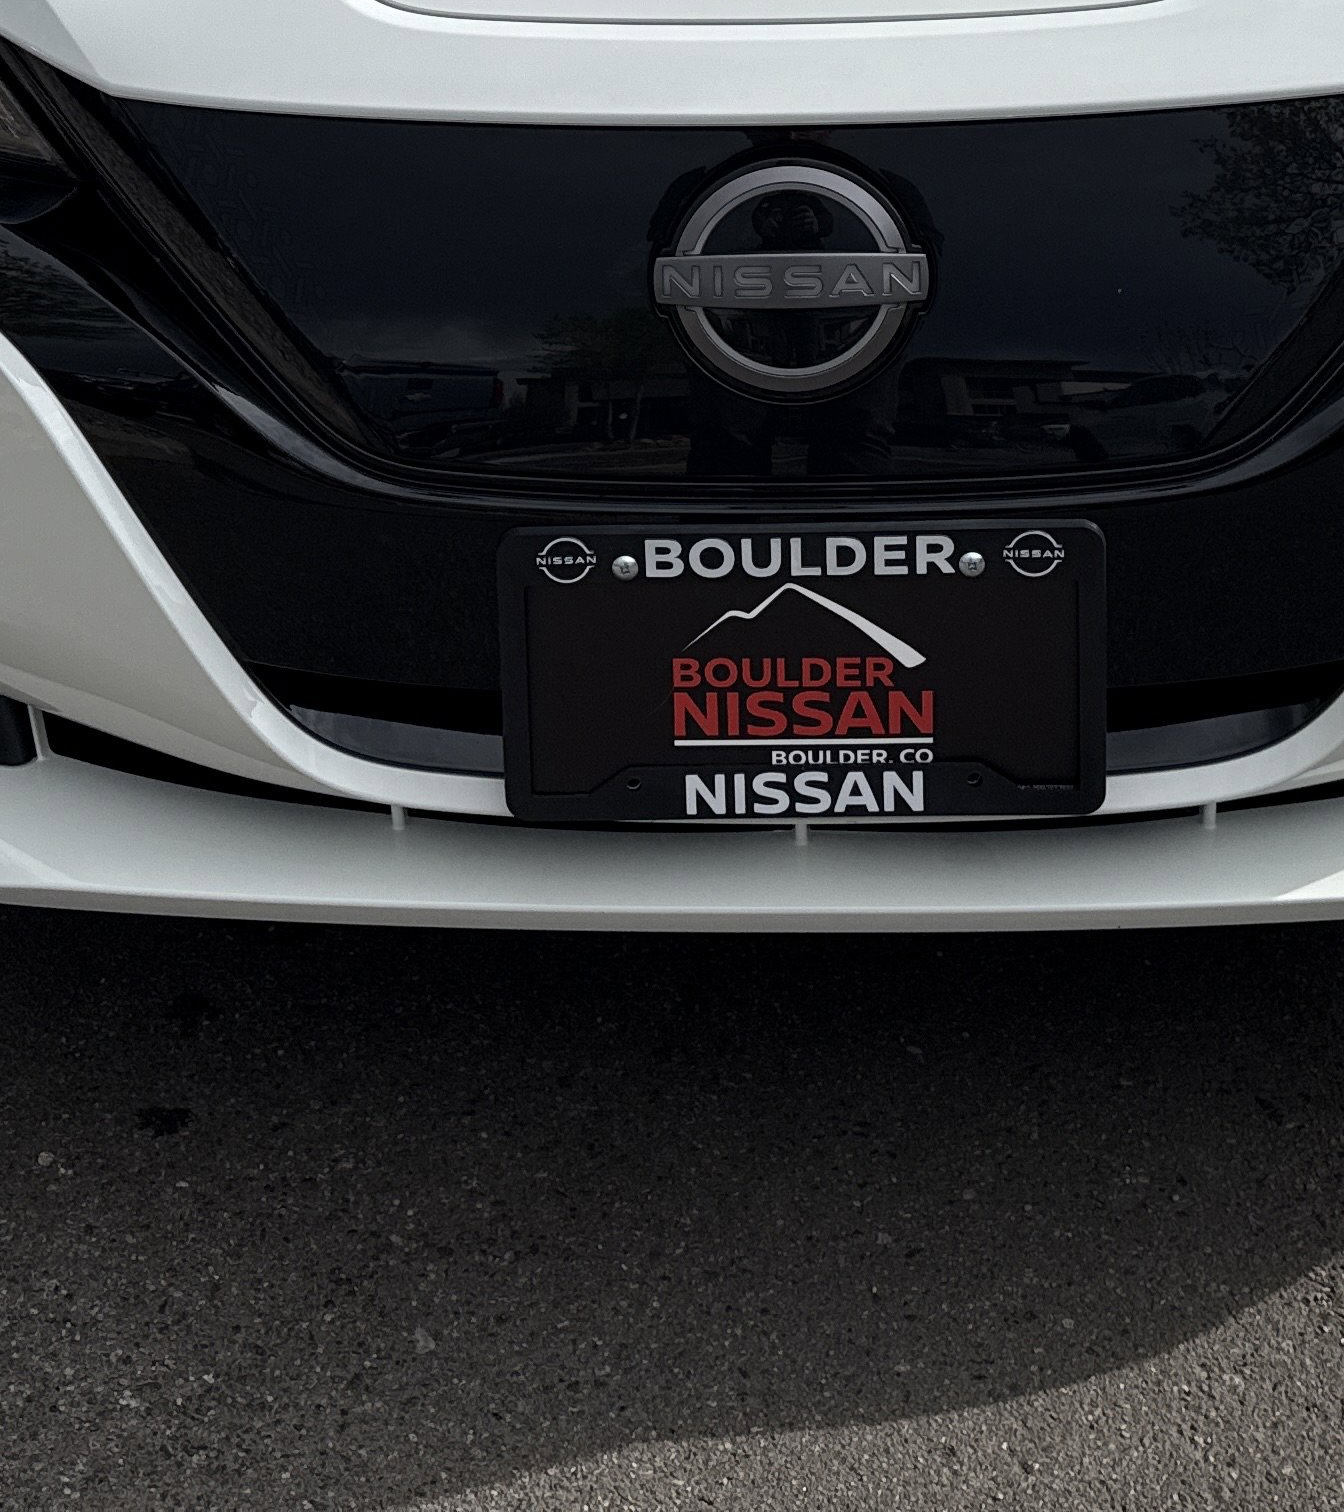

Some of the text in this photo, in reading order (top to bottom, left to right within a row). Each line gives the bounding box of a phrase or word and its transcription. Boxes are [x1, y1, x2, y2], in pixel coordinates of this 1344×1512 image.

[661, 261, 922, 299] NISSAN
[536, 555, 596, 565] NISSAN
[644, 535, 956, 578] BOULDER
[1002, 549, 1065, 558] NISSAN
[672, 657, 894, 688] BOULDER
[674, 690, 934, 737] NISSAN
[899, 748, 934, 764] CO
[685, 770, 925, 816] NISSAN
